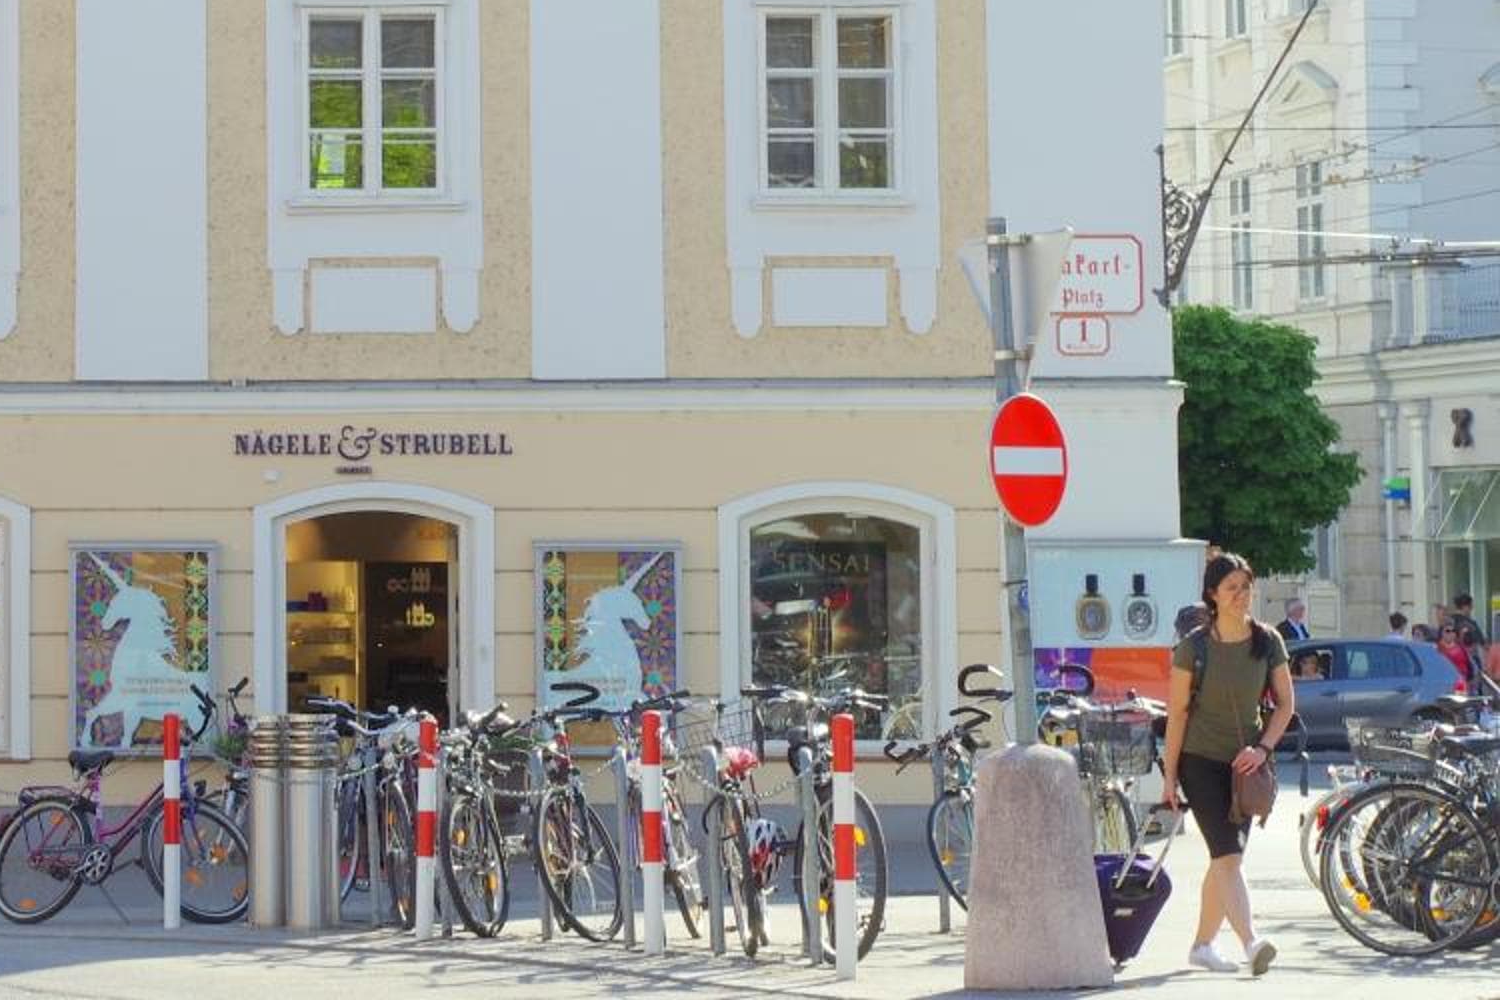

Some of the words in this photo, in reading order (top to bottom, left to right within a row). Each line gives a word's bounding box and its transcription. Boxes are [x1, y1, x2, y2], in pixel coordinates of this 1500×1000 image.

[1080, 320, 1087, 342] 1
[234, 430, 332, 455] NÄGELE
[379, 433, 513, 455] STRUBELL
